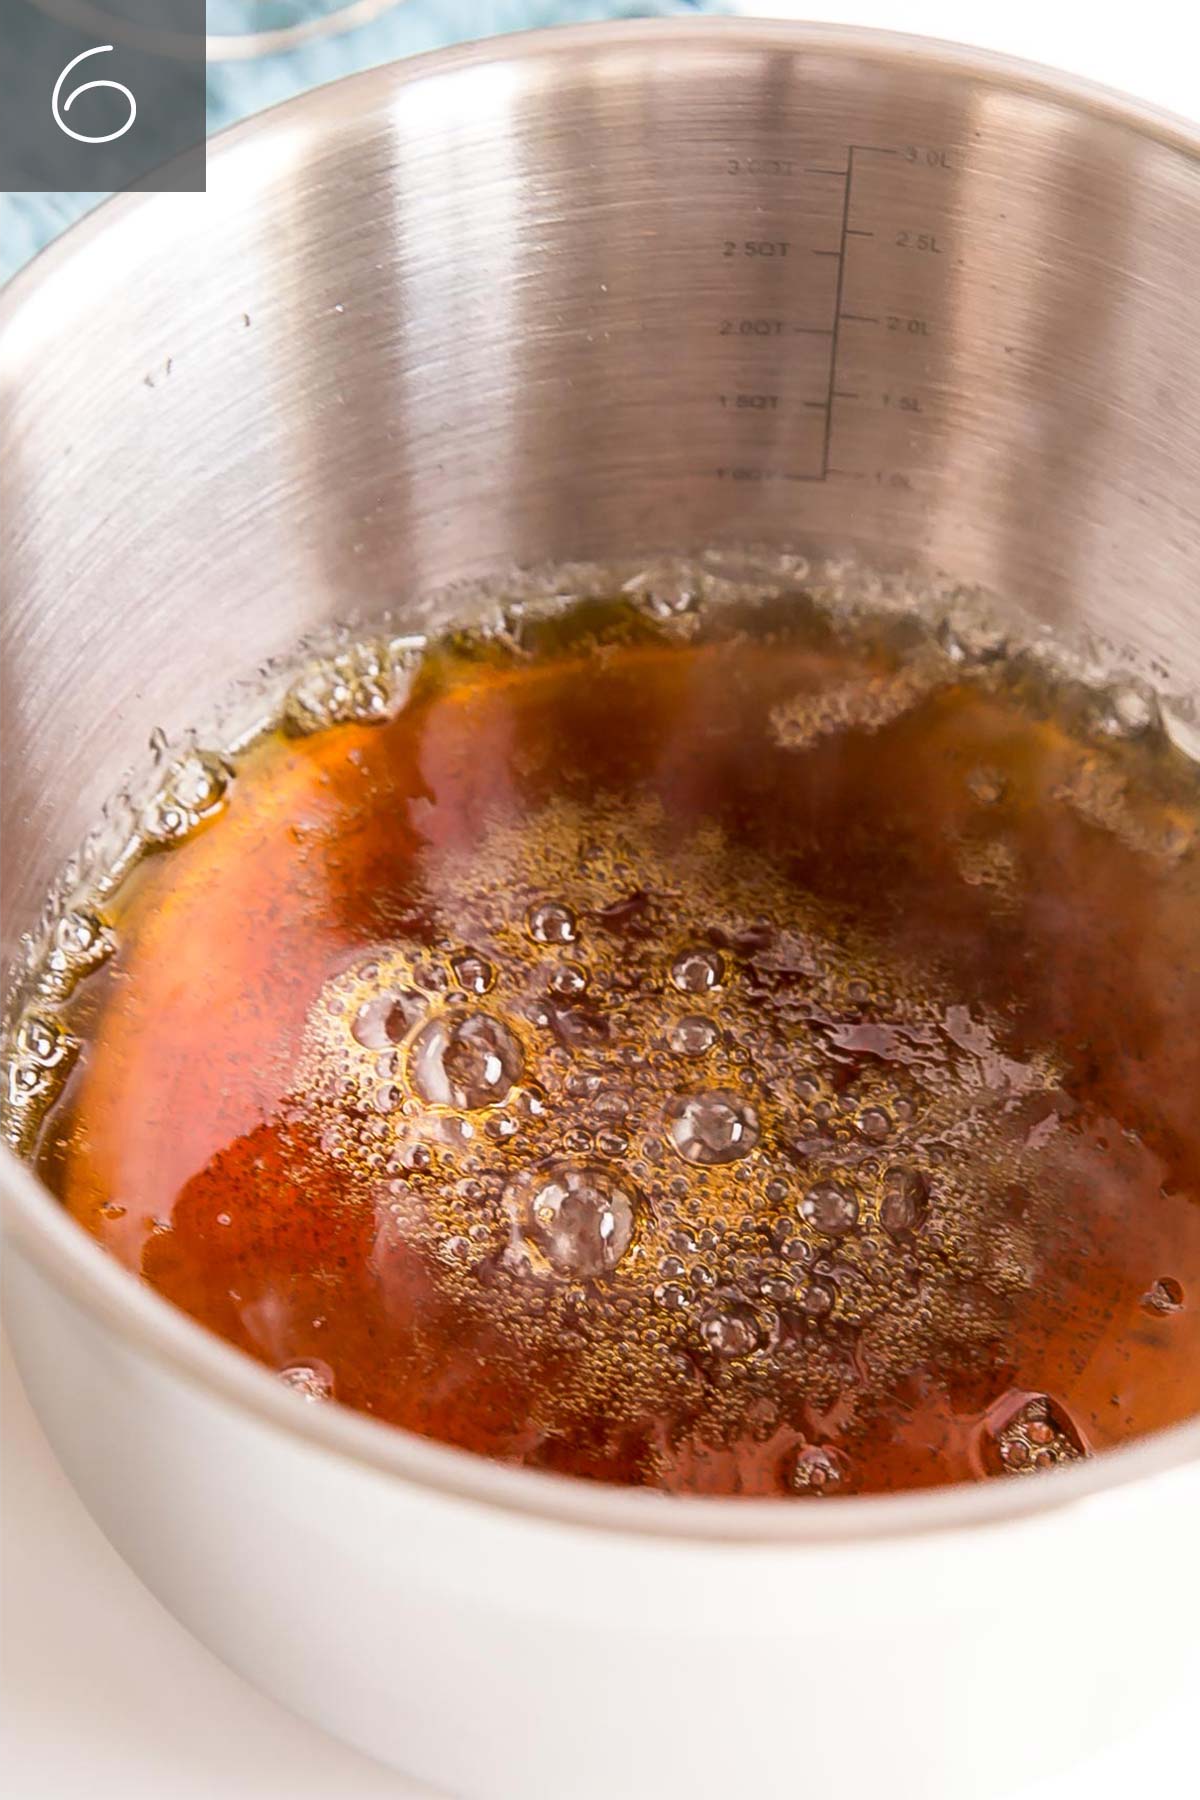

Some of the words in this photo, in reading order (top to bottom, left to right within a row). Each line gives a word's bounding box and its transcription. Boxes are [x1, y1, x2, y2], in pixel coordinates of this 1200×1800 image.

[904, 147, 952, 169] 30L
[723, 242, 791, 257] 25QT
[896, 232, 944, 253] 25L
[886, 315, 930, 336] 20L
[719, 395, 779, 409] 15QT
[882, 396, 923, 413] 15L
